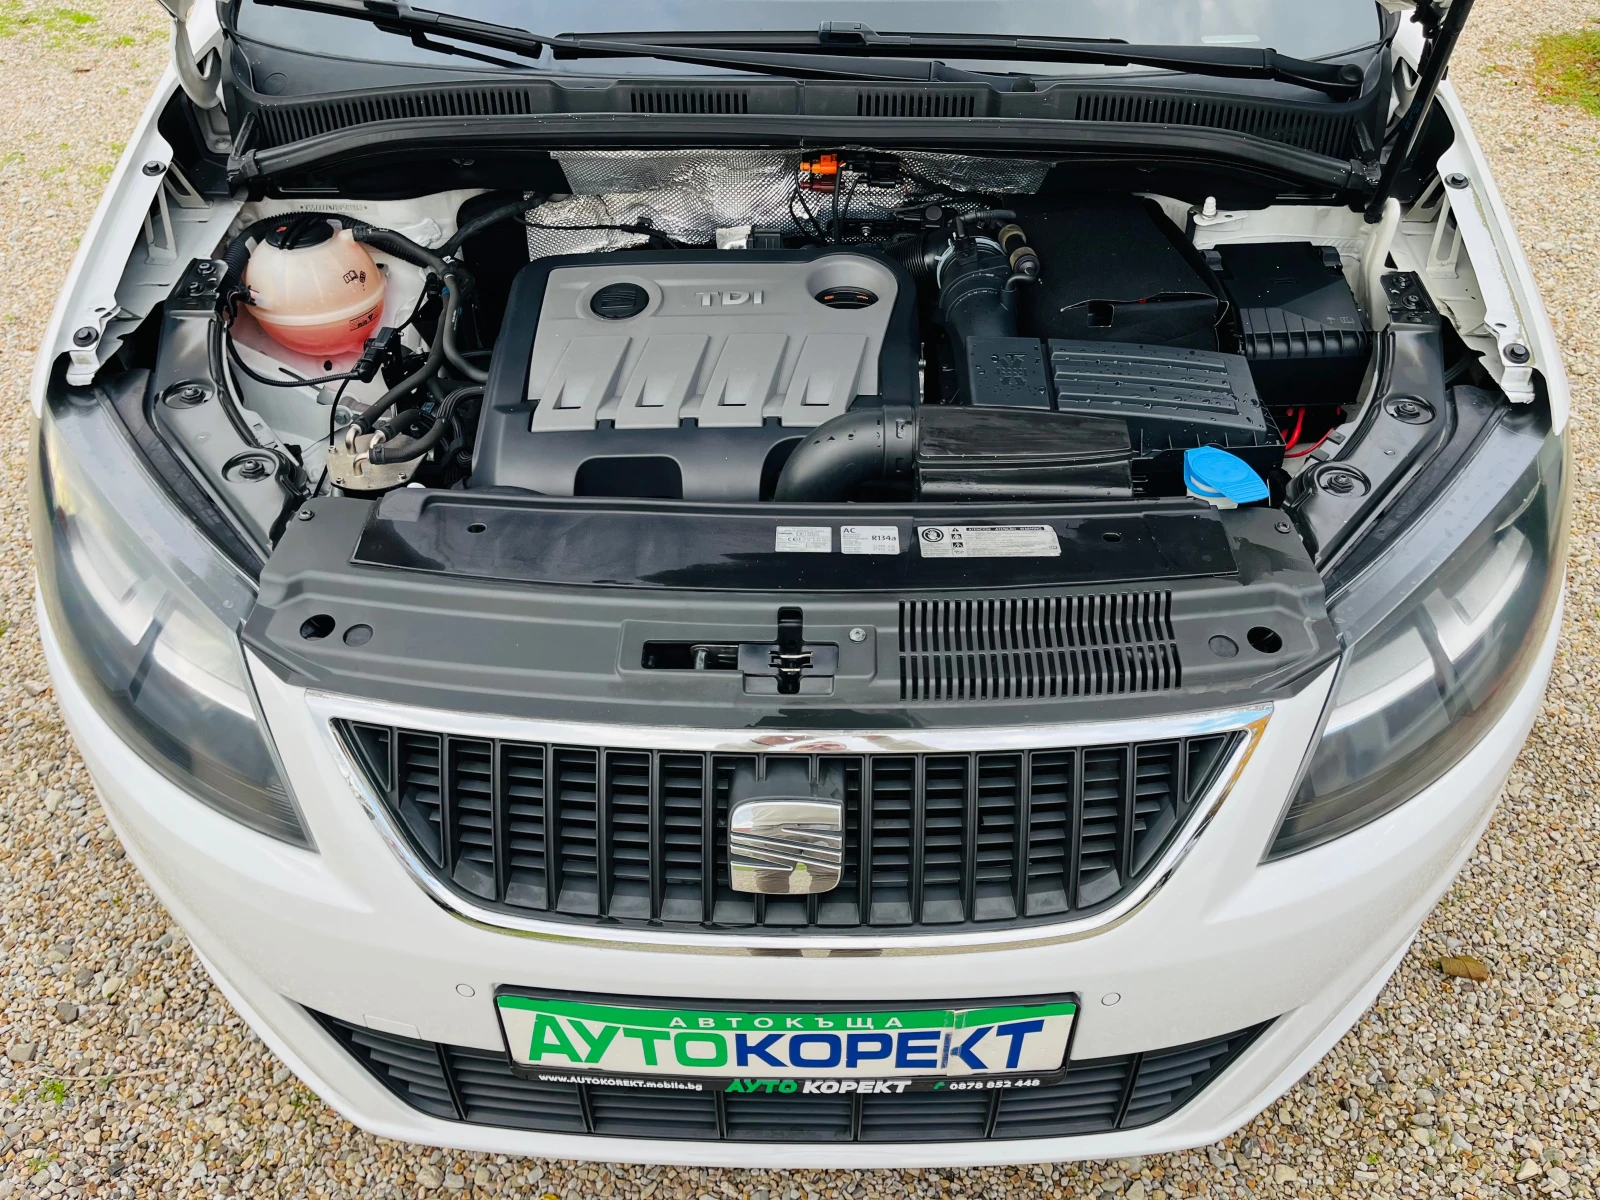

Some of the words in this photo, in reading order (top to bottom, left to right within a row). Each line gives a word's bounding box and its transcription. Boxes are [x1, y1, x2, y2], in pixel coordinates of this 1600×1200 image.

[694, 290, 764, 306] TDI
[669, 1017, 903, 1030] АВТОКЪЩА
[529, 1013, 1045, 1069] АУТОКОРЕКТ
[538, 1074, 703, 1091] www.AUTOKOREKT.mobile.bg
[724, 1079, 798, 1093] АУТО
[802, 1079, 912, 1094] КОРЕКТ
[950, 1081, 984, 1090] 0878
[986, 1081, 1012, 1089] 852
[1014, 1079, 1041, 1087] 448
